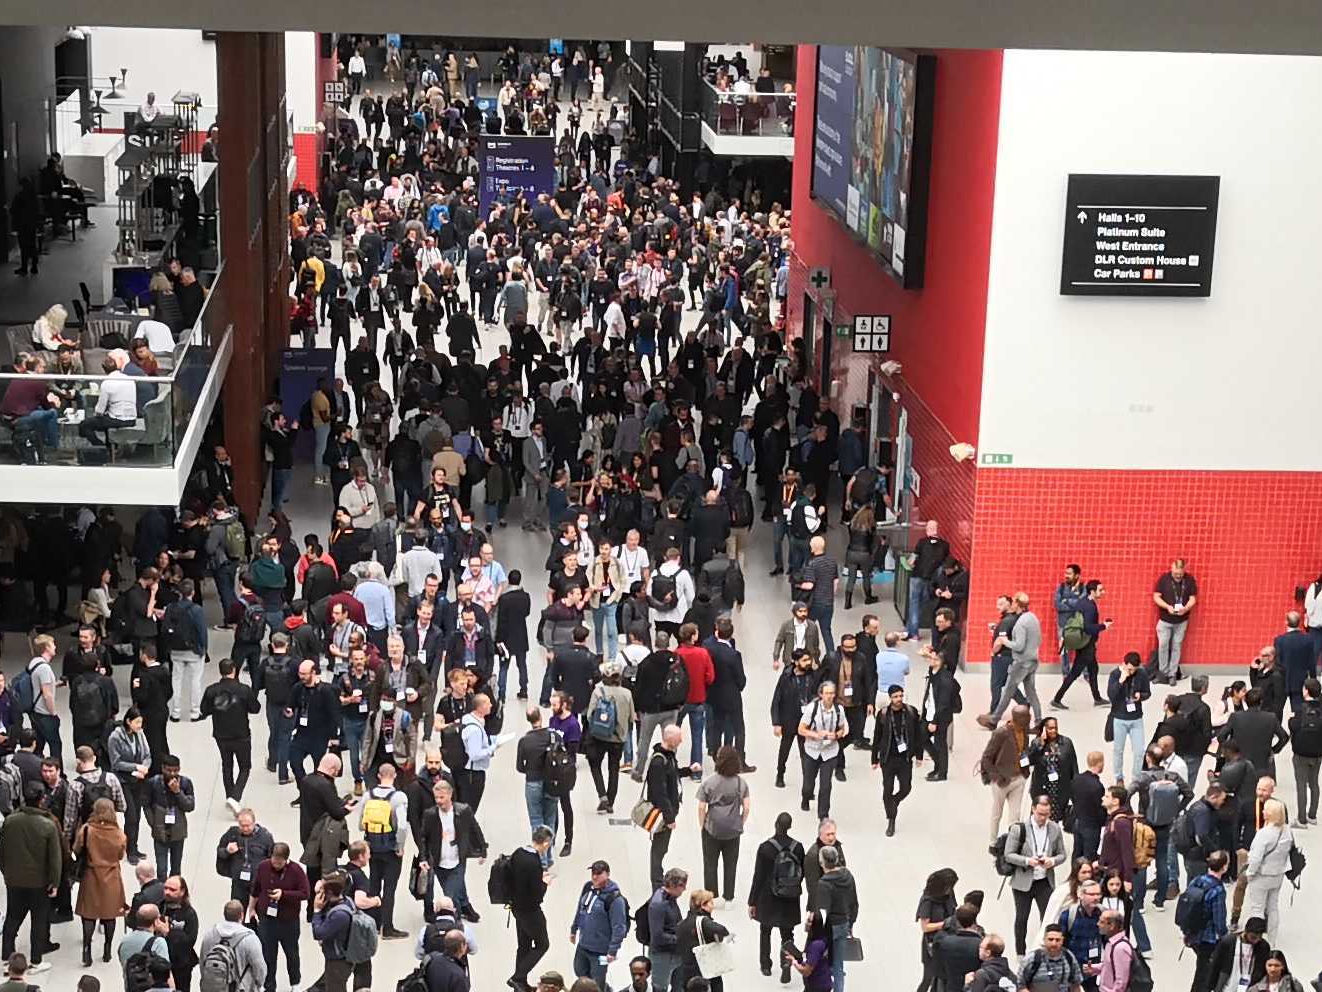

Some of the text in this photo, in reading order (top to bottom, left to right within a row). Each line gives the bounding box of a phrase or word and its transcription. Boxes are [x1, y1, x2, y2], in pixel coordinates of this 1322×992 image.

[1098, 212, 1123, 223] Halls
[1097, 227, 1166, 237] Platinum Suite
[1096, 241, 1165, 251] West Entrance
[1094, 255, 1187, 266] DLR Custom House
[1093, 269, 1112, 278] Car
[1113, 269, 1141, 279] Parks
